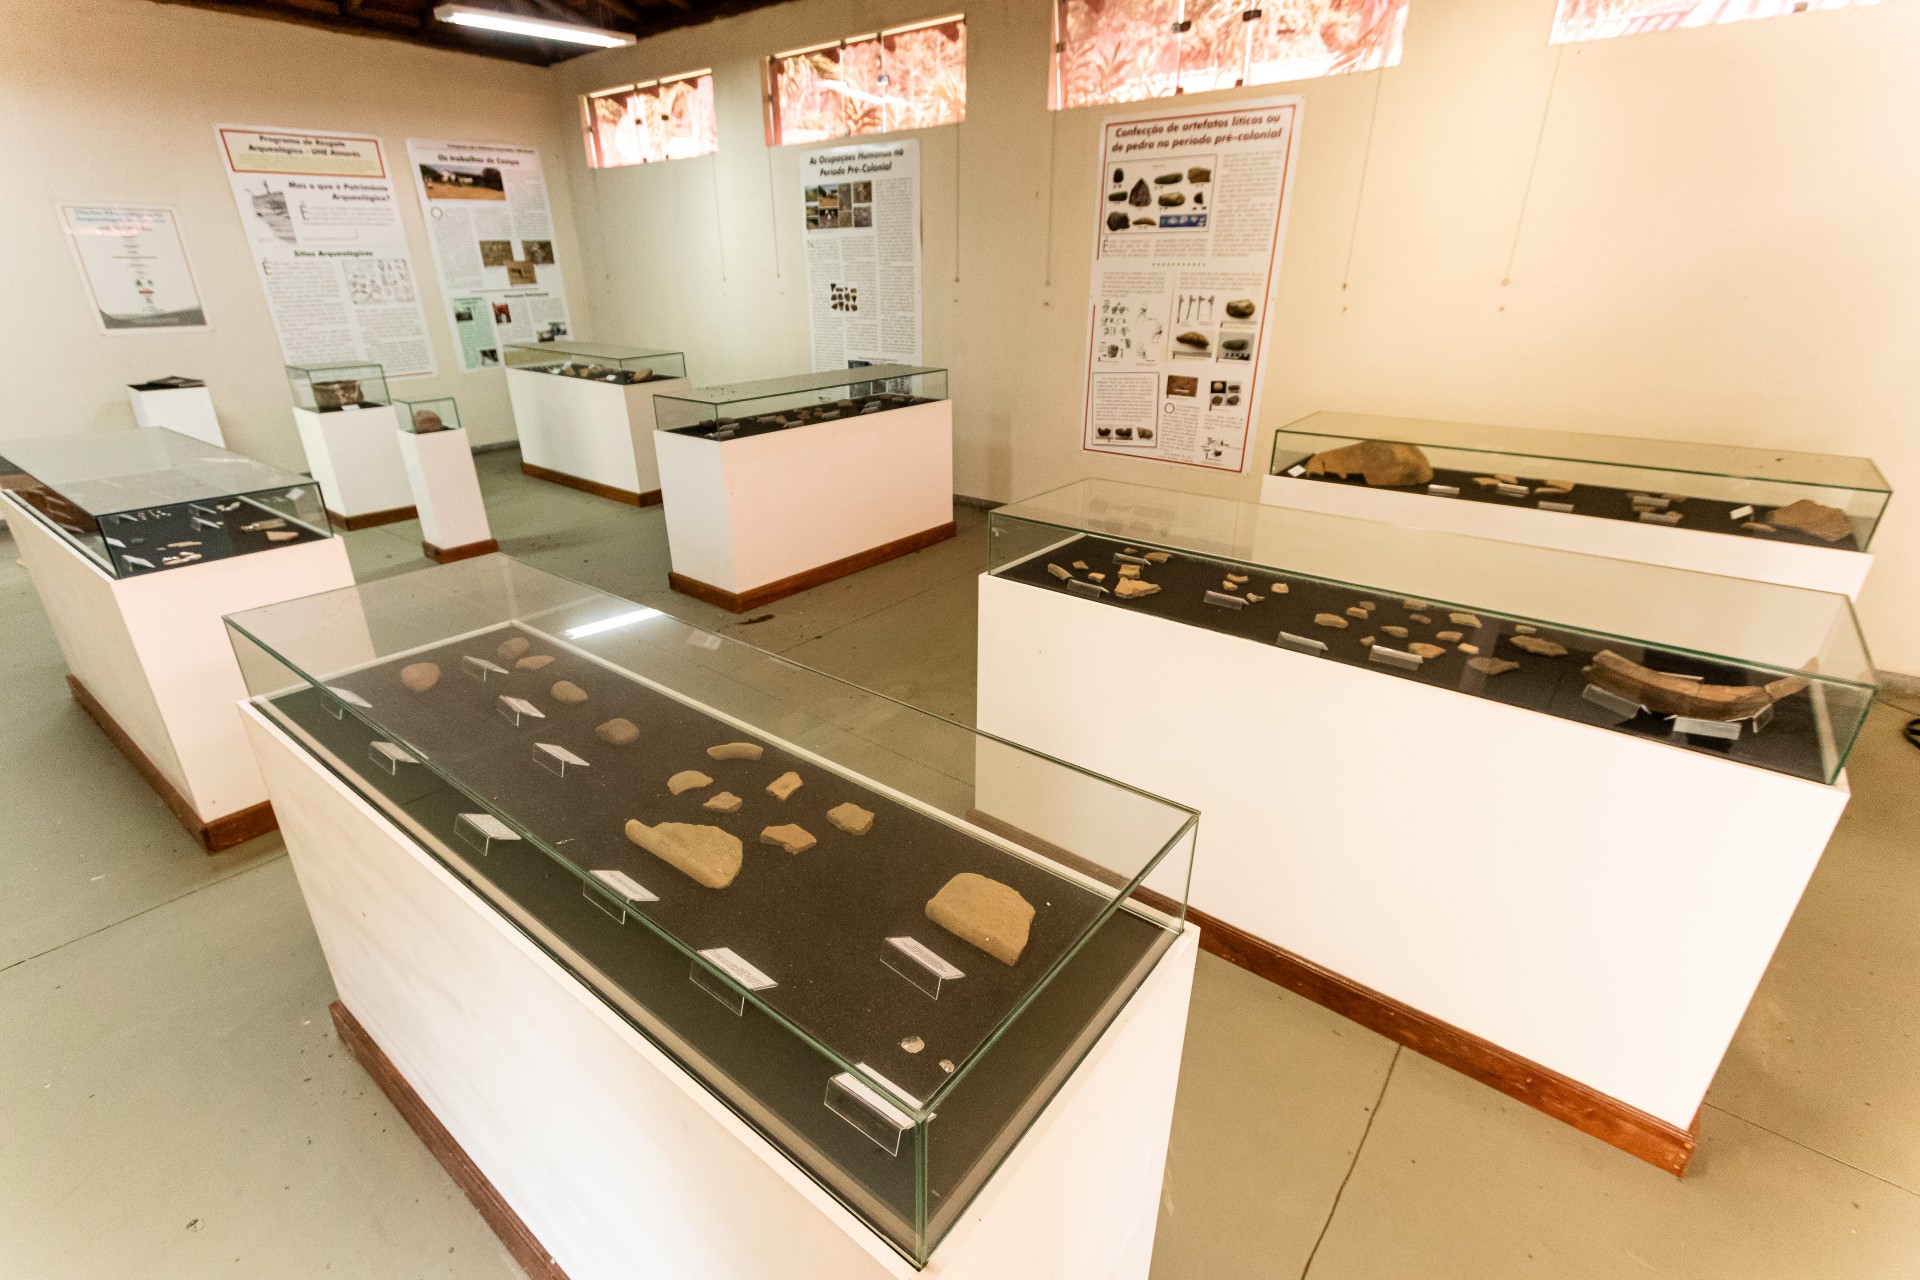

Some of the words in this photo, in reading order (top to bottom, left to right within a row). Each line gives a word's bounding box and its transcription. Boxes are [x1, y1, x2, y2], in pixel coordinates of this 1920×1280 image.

[1182, 118, 1229, 131] artefatos
[1266, 114, 1281, 124] ou
[1125, 140, 1155, 153] pedra
